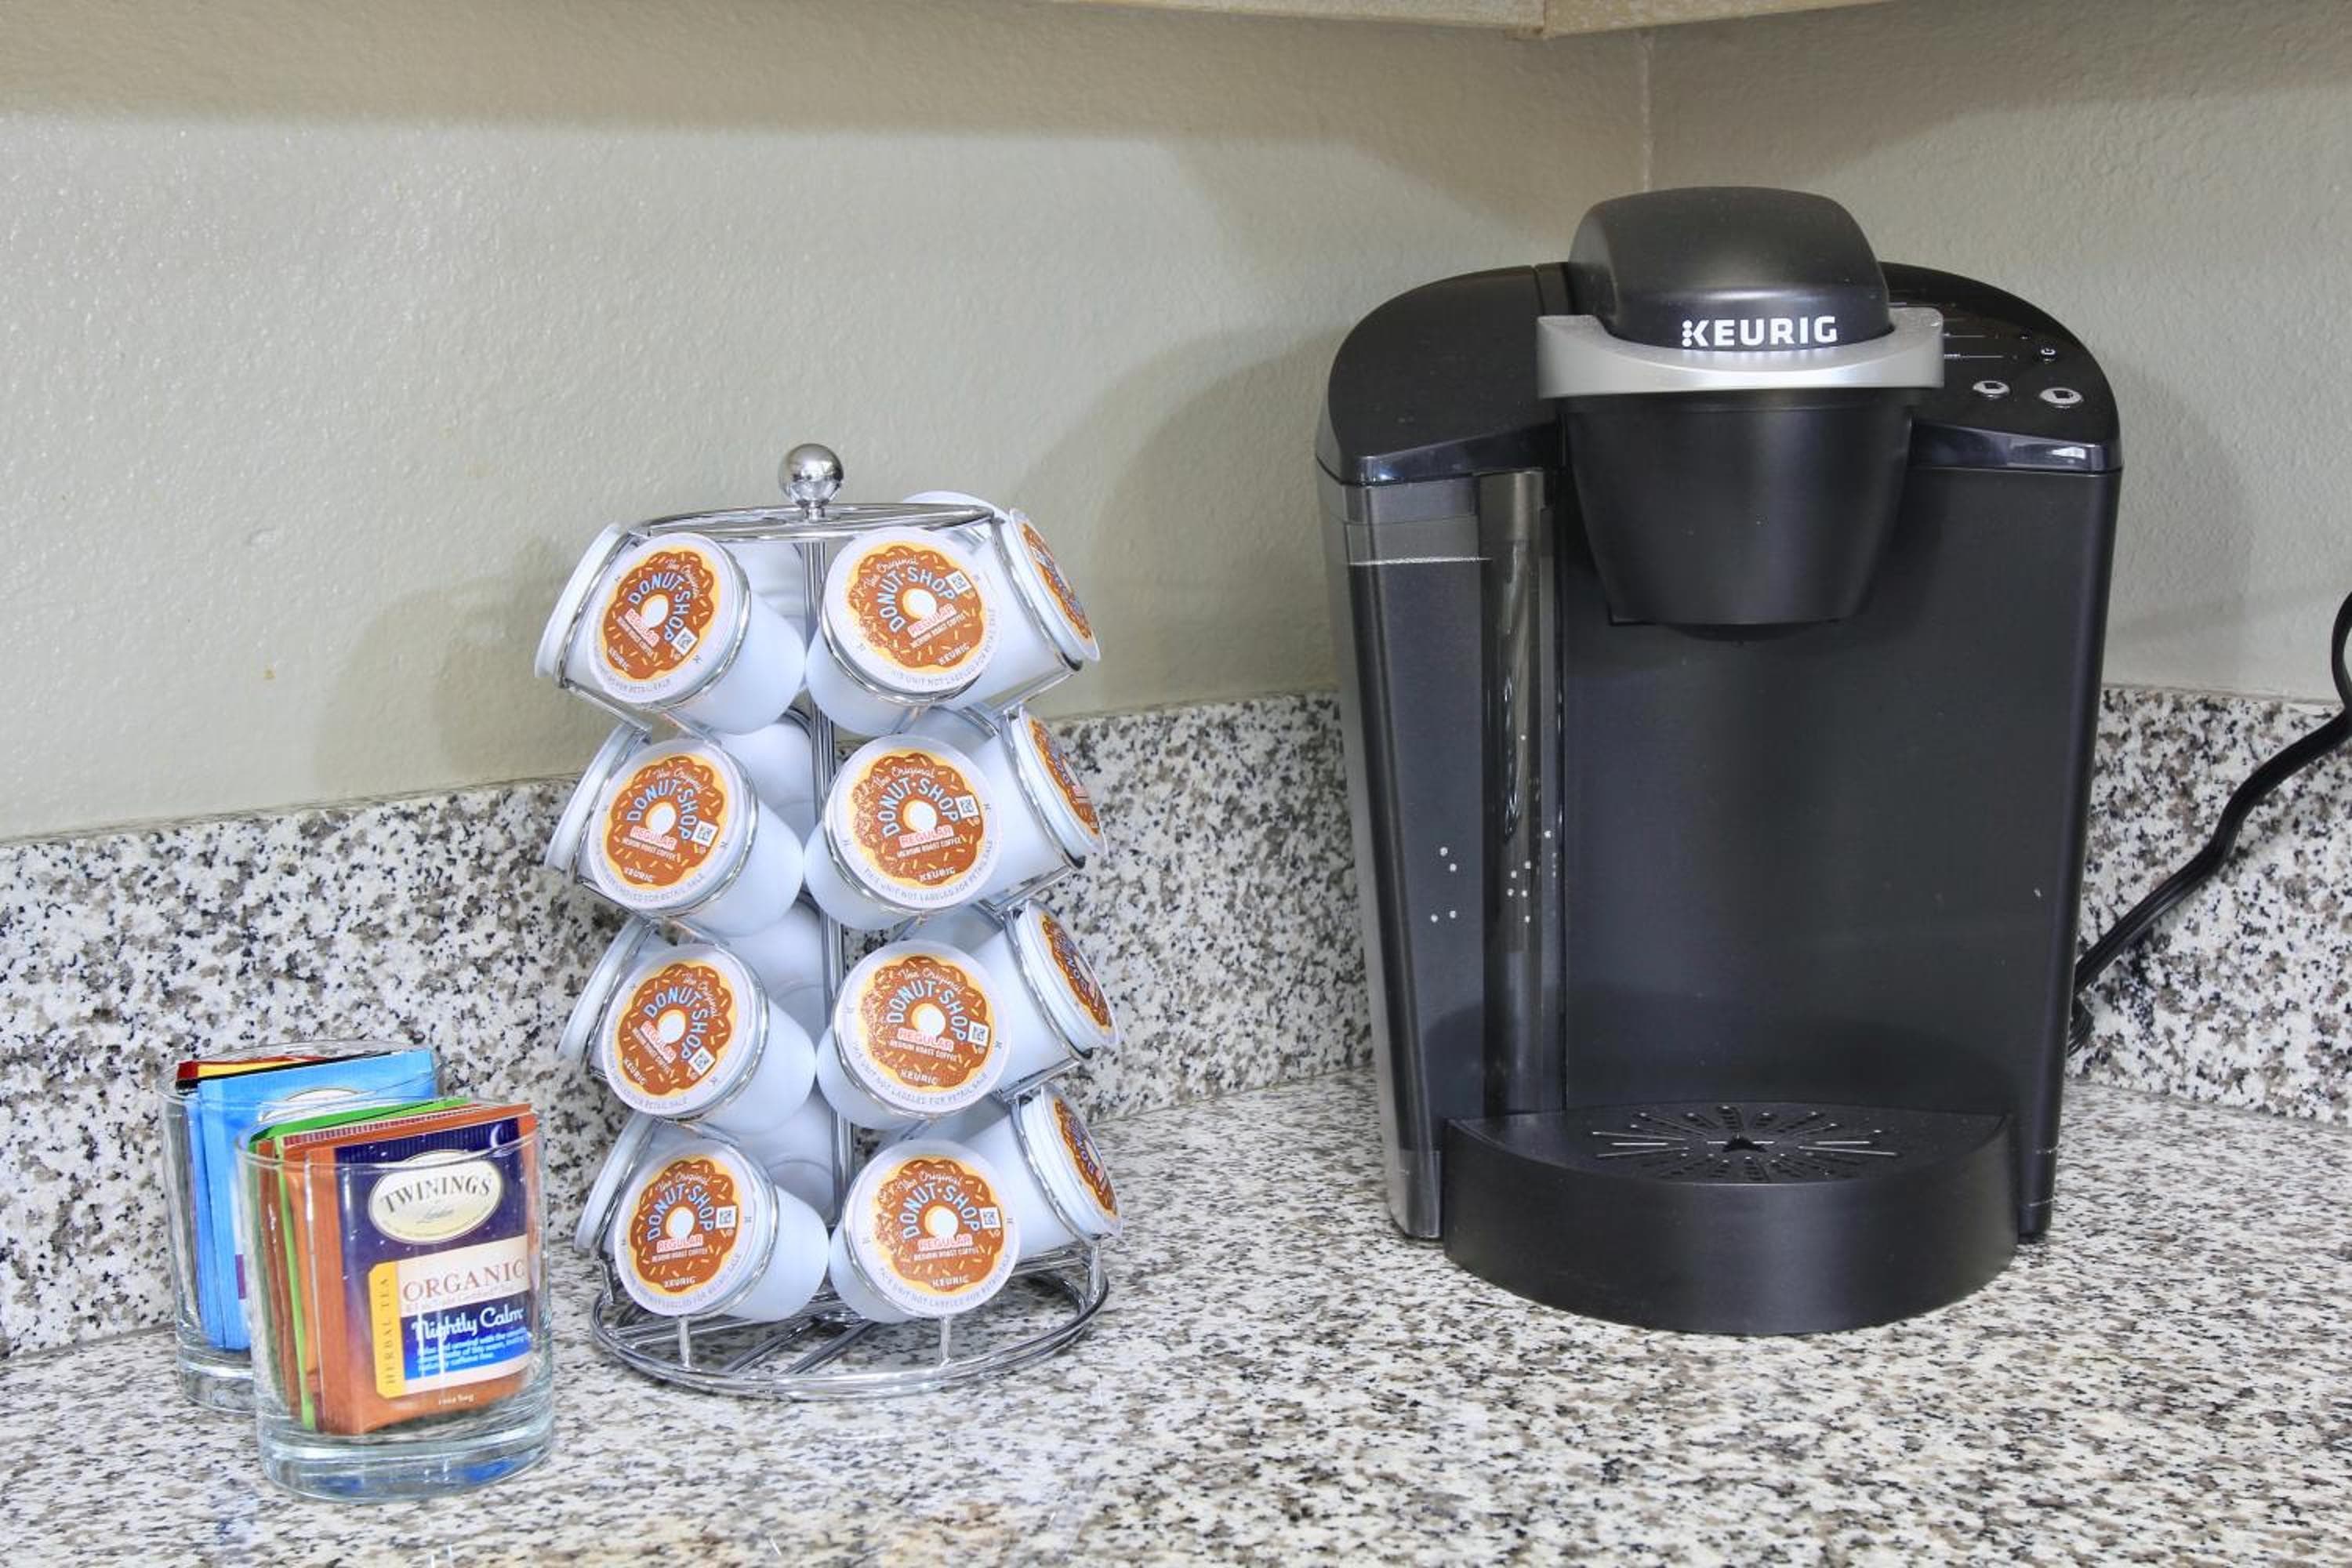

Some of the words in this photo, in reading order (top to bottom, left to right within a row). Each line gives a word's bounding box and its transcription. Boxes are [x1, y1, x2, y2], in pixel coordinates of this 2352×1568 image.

[1682, 315, 1838, 347] KEURIG
[628, 573, 684, 605] DONUT
[664, 590, 691, 641] SHOP
[877, 570, 906, 633] DONUT
[907, 566, 957, 601] SHOP
[625, 608, 659, 647] REGULAR
[909, 604, 956, 637] REGULAR
[938, 644, 970, 666] KEURIG
[627, 779, 682, 822] DONUT
[677, 789, 698, 840] SHOP
[877, 777, 912, 838] DONUT
[918, 778, 960, 822] SHOP
[631, 826, 677, 851] REGULAR
[899, 825, 954, 848] REGULAR
[644, 987, 703, 1018] DONUT
[681, 1008, 708, 1060] SHOP
[886, 980, 936, 1023] DONUT
[938, 989, 967, 1041] SHOP
[640, 1019, 677, 1064] REGULAR
[897, 1027, 954, 1052] REGULAR
[900, 1069, 938, 1086] KEURIG
[383, 1175, 492, 1213] TWININGS
[647, 1183, 685, 1242] DONUT
[688, 1185, 715, 1232] SHOP
[899, 1182, 936, 1239] DONUT
[943, 1185, 980, 1232] SHOP
[657, 1234, 703, 1253] REGULAR
[917, 1234, 972, 1251] REGULAR
[380, 1279, 390, 1308] TEA
[403, 1259, 527, 1301] ORGANIC
[664, 1276, 697, 1288] KEURIG
[932, 1274, 969, 1287] KEURIG
[412, 1312, 477, 1341] Nightly
[480, 1304, 524, 1327] Calm
[382, 1321, 395, 1384] HERBAL
